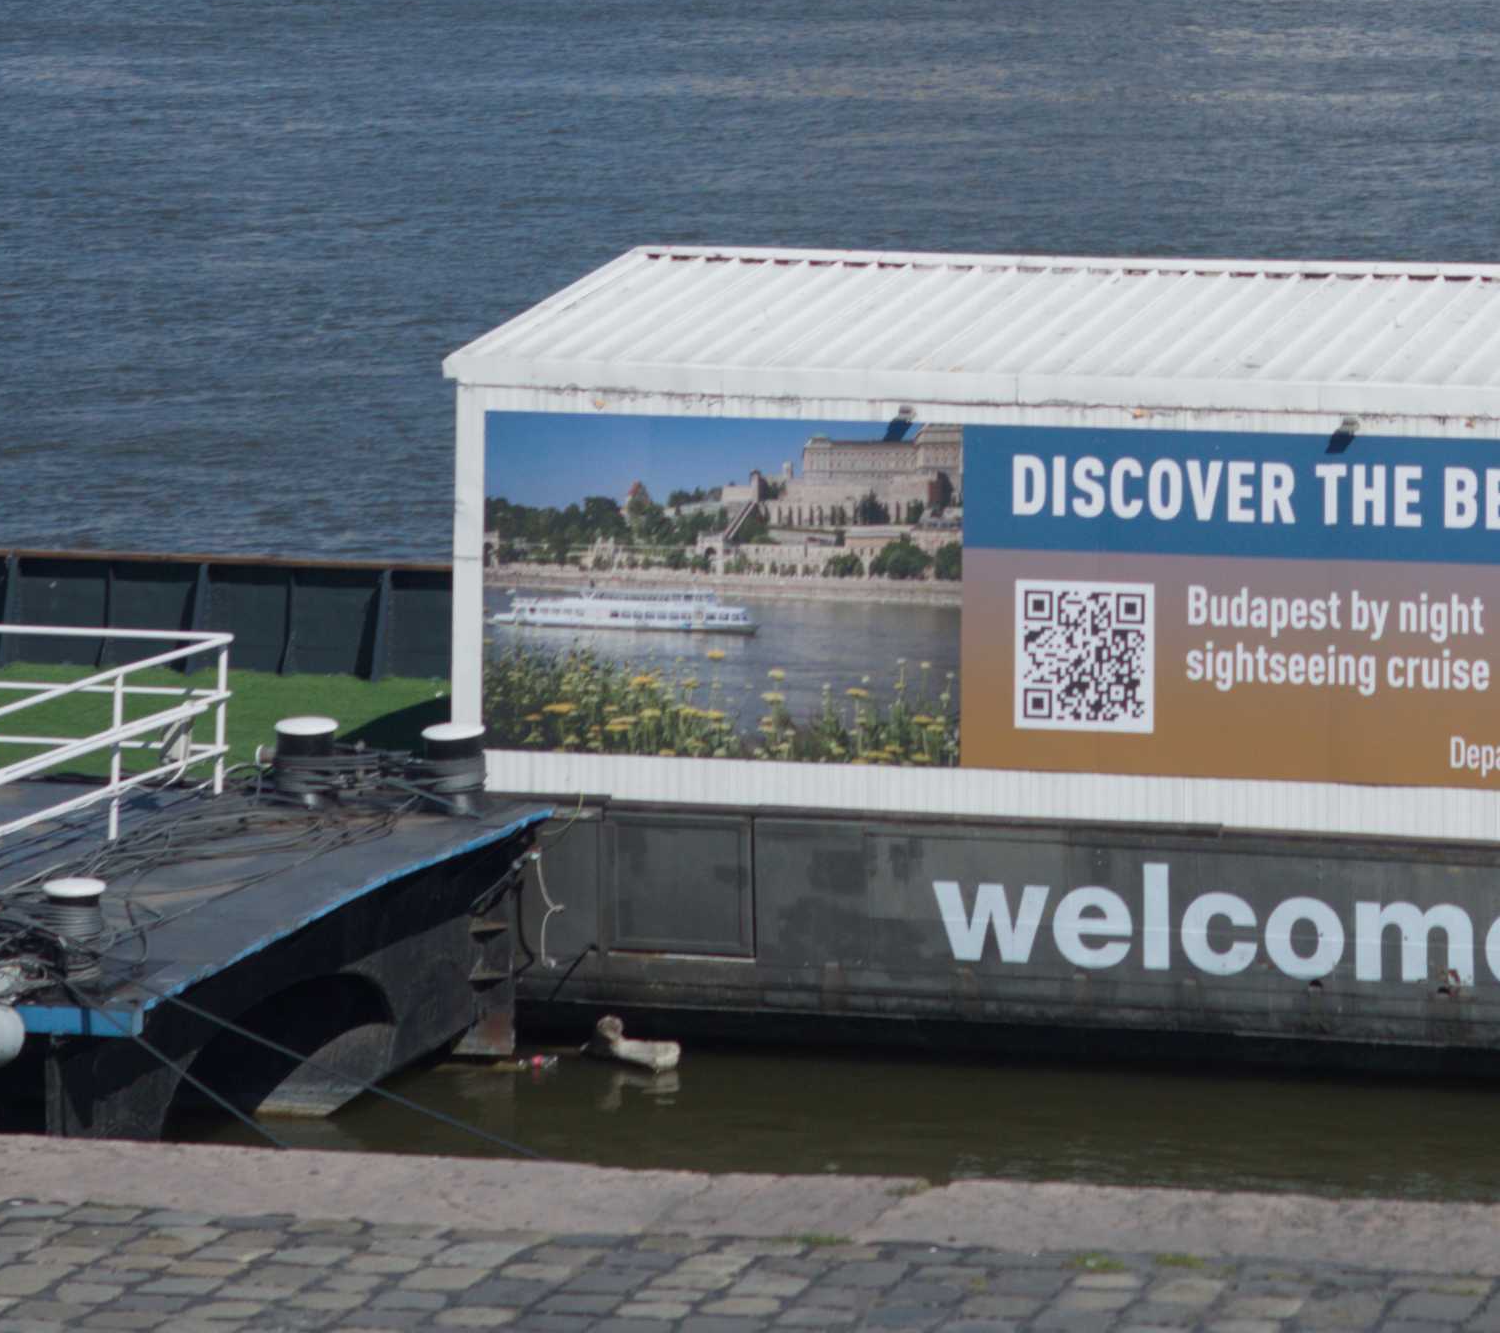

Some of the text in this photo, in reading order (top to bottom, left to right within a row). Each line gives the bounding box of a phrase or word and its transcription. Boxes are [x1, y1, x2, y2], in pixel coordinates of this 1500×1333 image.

[1012, 454, 1296, 525] DISCOVER
[1315, 463, 1423, 528] THE
[1187, 585, 1484, 642] Budapest by night
[1186, 642, 1490, 697] sightseeing cruise
